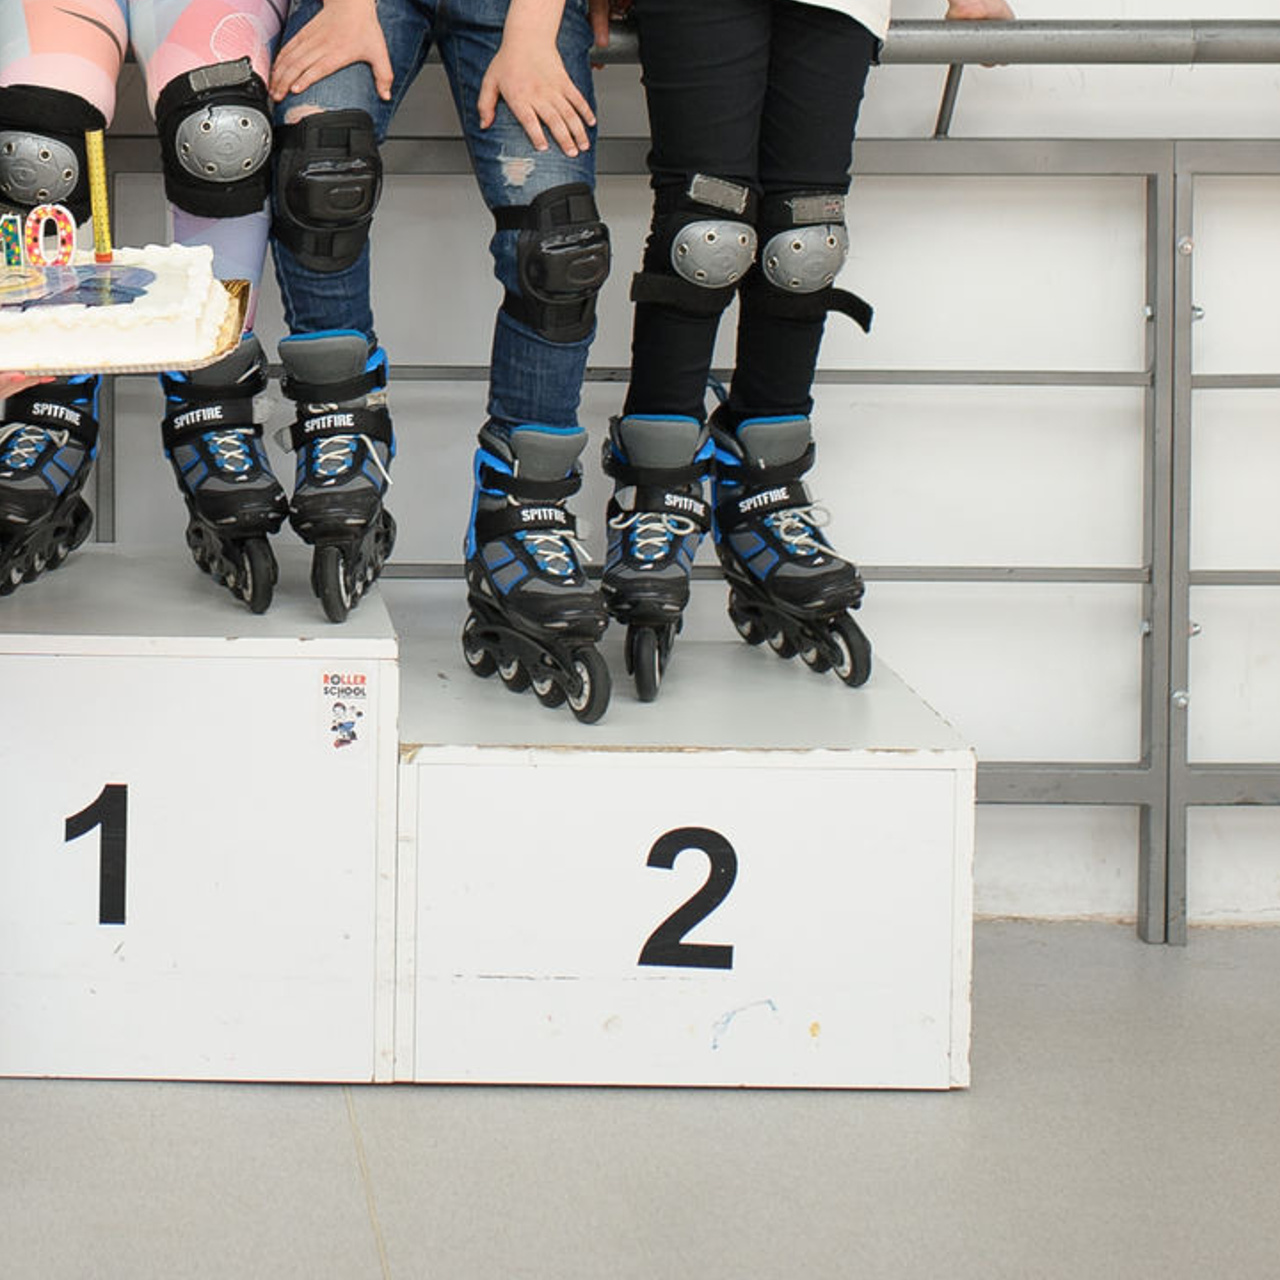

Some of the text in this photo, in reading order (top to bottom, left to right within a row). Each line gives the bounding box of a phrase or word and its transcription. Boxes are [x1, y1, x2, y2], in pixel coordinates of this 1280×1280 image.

[31, 402, 81, 426] SPITFIRE
[173, 405, 223, 429] SPITFIRE
[304, 413, 355, 432] SPITFIRE
[738, 487, 790, 513] SPITFIRE
[323, 674, 367, 685] ROLLER
[323, 686, 367, 698] SCHOOL
[65, 784, 128, 926] 1
[637, 826, 739, 971] 2
